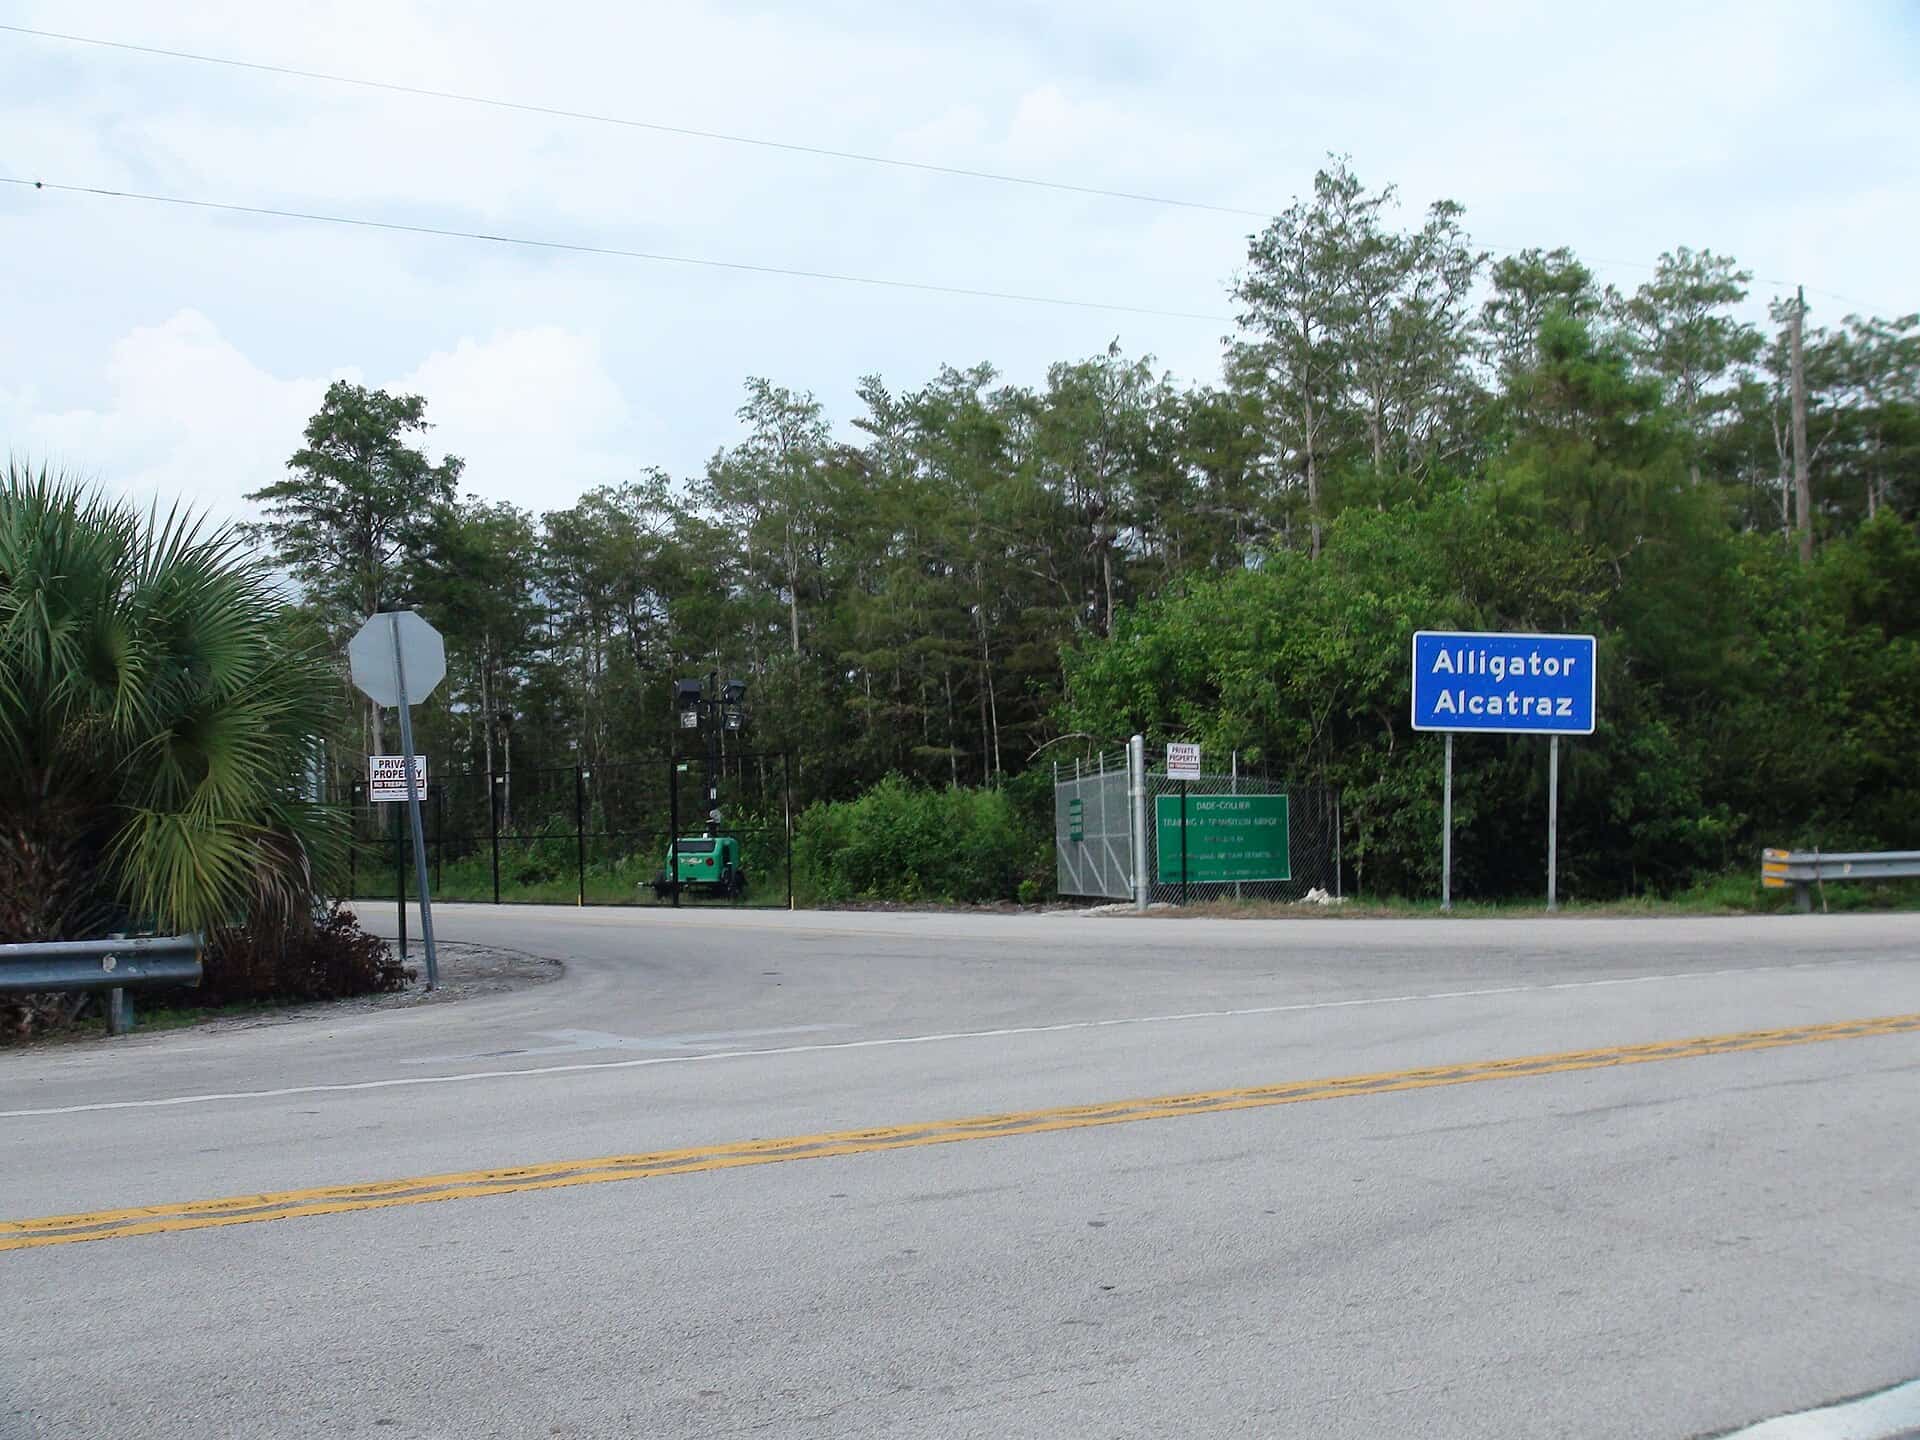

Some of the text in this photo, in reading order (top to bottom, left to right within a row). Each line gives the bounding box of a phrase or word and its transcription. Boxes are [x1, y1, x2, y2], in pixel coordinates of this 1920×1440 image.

[1431, 649, 1576, 683] Alligator
[1433, 689, 1573, 716] Alcatraz
[379, 760, 416, 768] PRIVAE
[374, 770, 422, 778] PROPEY
[1196, 801, 1250, 810] DADE-COLLIER
